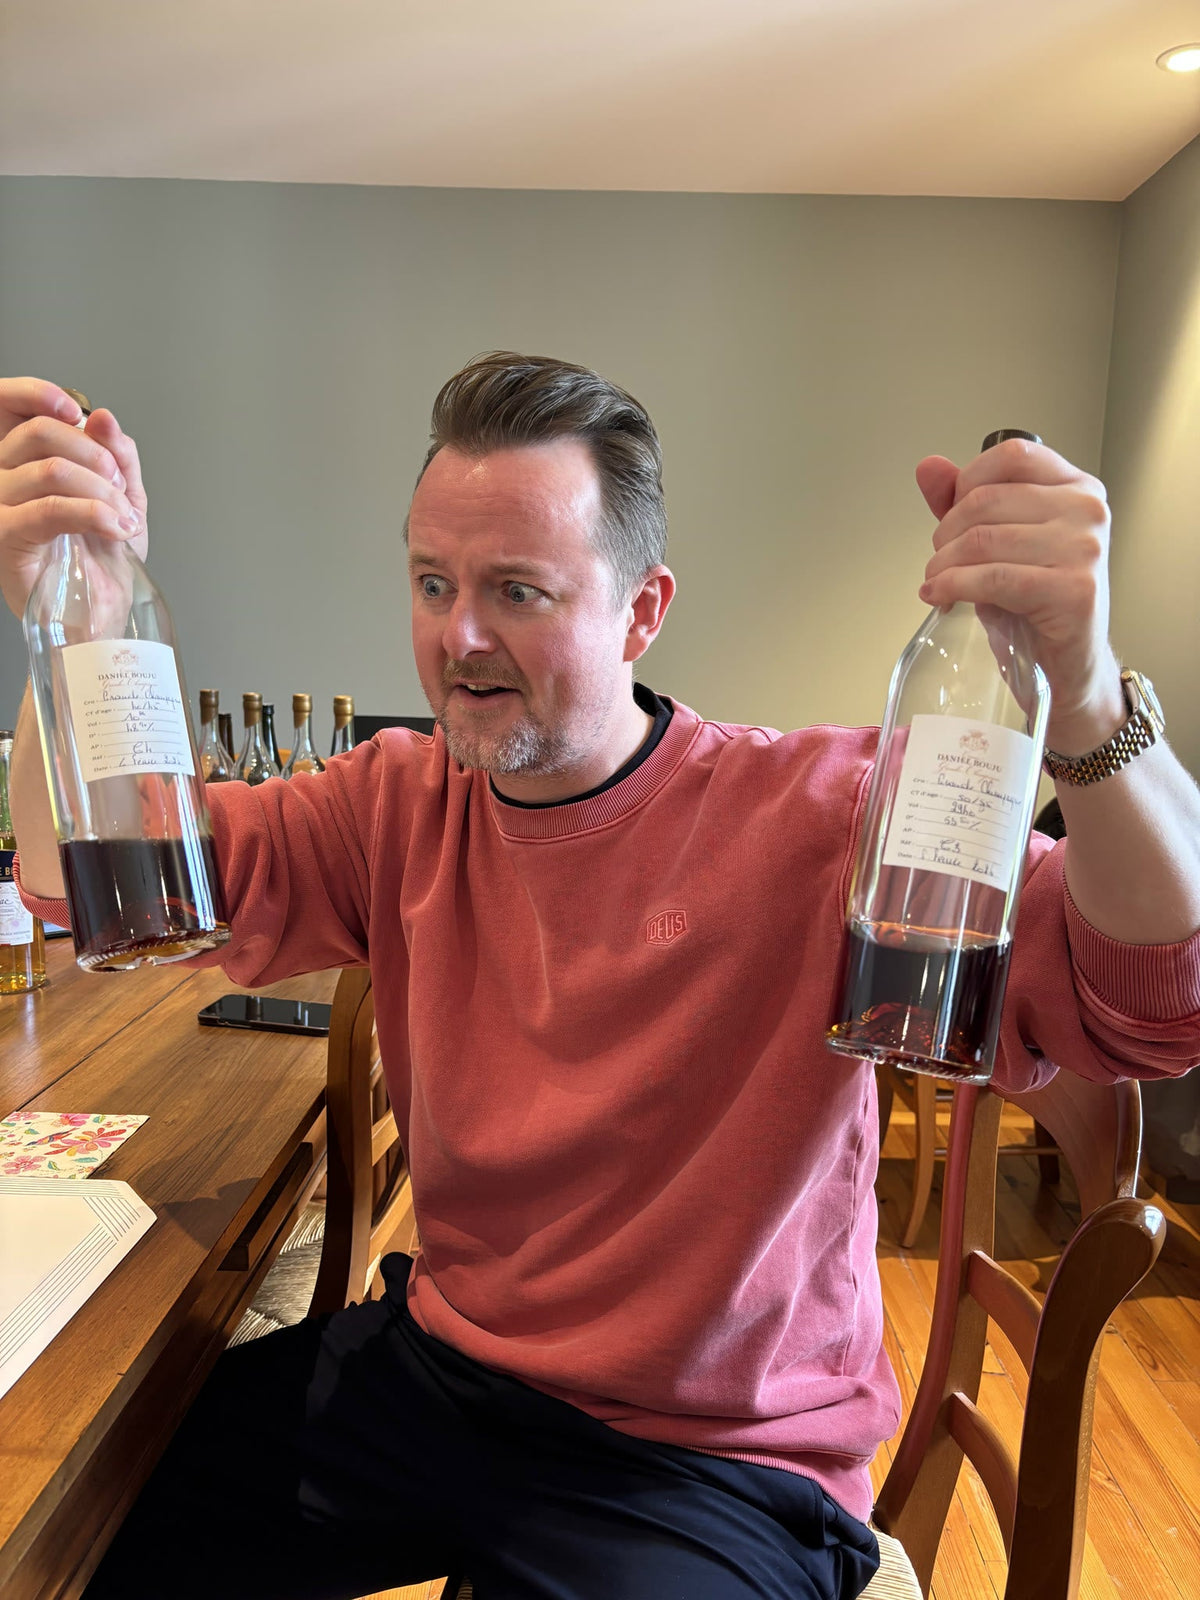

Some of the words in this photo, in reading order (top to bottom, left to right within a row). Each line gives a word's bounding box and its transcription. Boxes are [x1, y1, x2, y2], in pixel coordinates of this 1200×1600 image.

[98, 672, 128, 680] DANIEL
[937, 753, 970, 765] DANIEL
[973, 759, 1002, 773] BOUJU
[650, 914, 683, 939] DEUS
